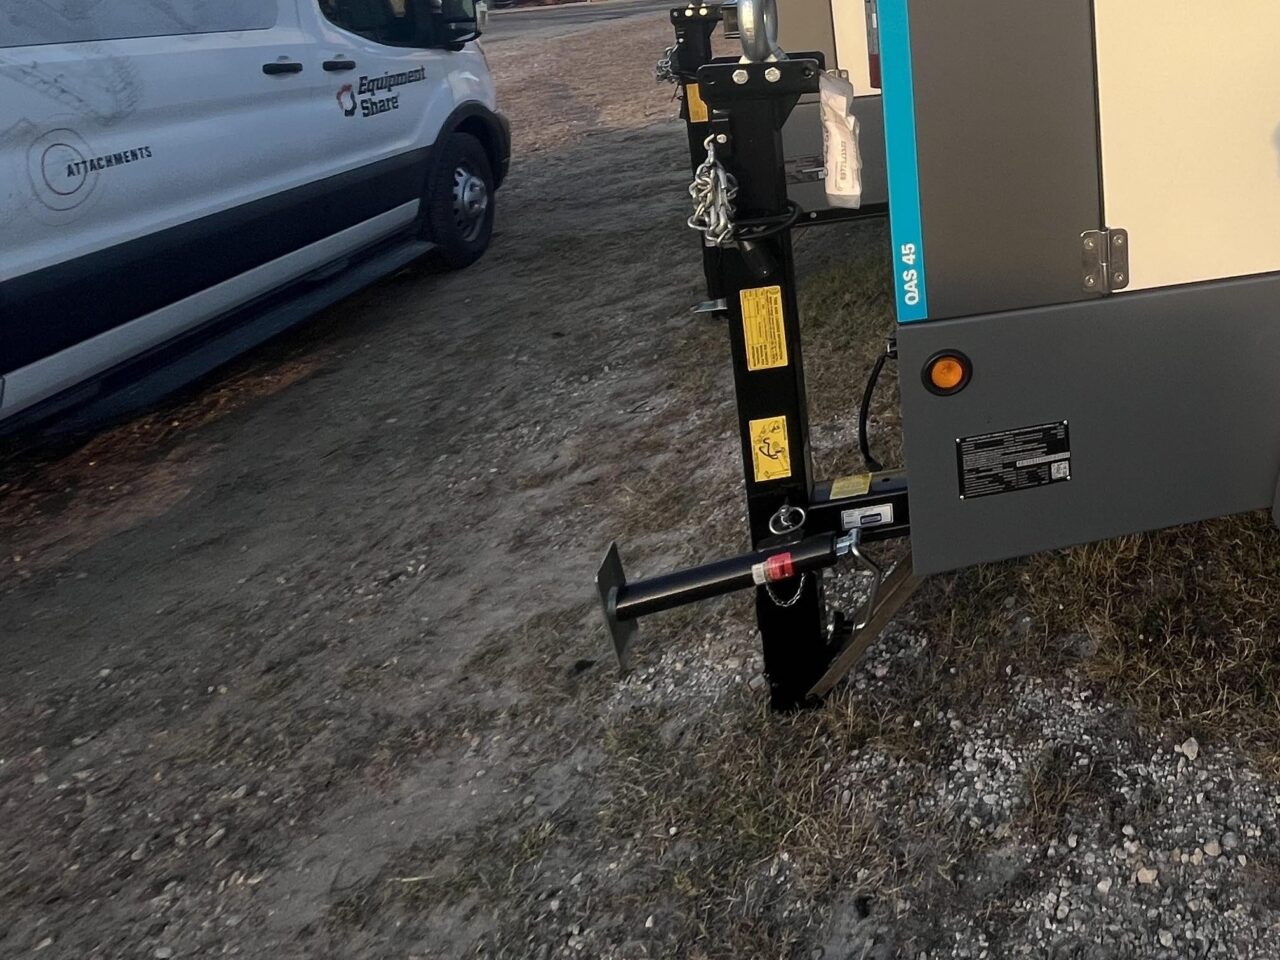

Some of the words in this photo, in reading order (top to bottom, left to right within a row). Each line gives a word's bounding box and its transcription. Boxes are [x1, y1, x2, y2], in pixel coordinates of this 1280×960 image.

[357, 65, 427, 96] Equipment
[360, 96, 399, 117] Share
[67, 146, 152, 177] ATTACHMENTS
[901, 243, 916, 265] 45
[903, 269, 919, 305] QAS
